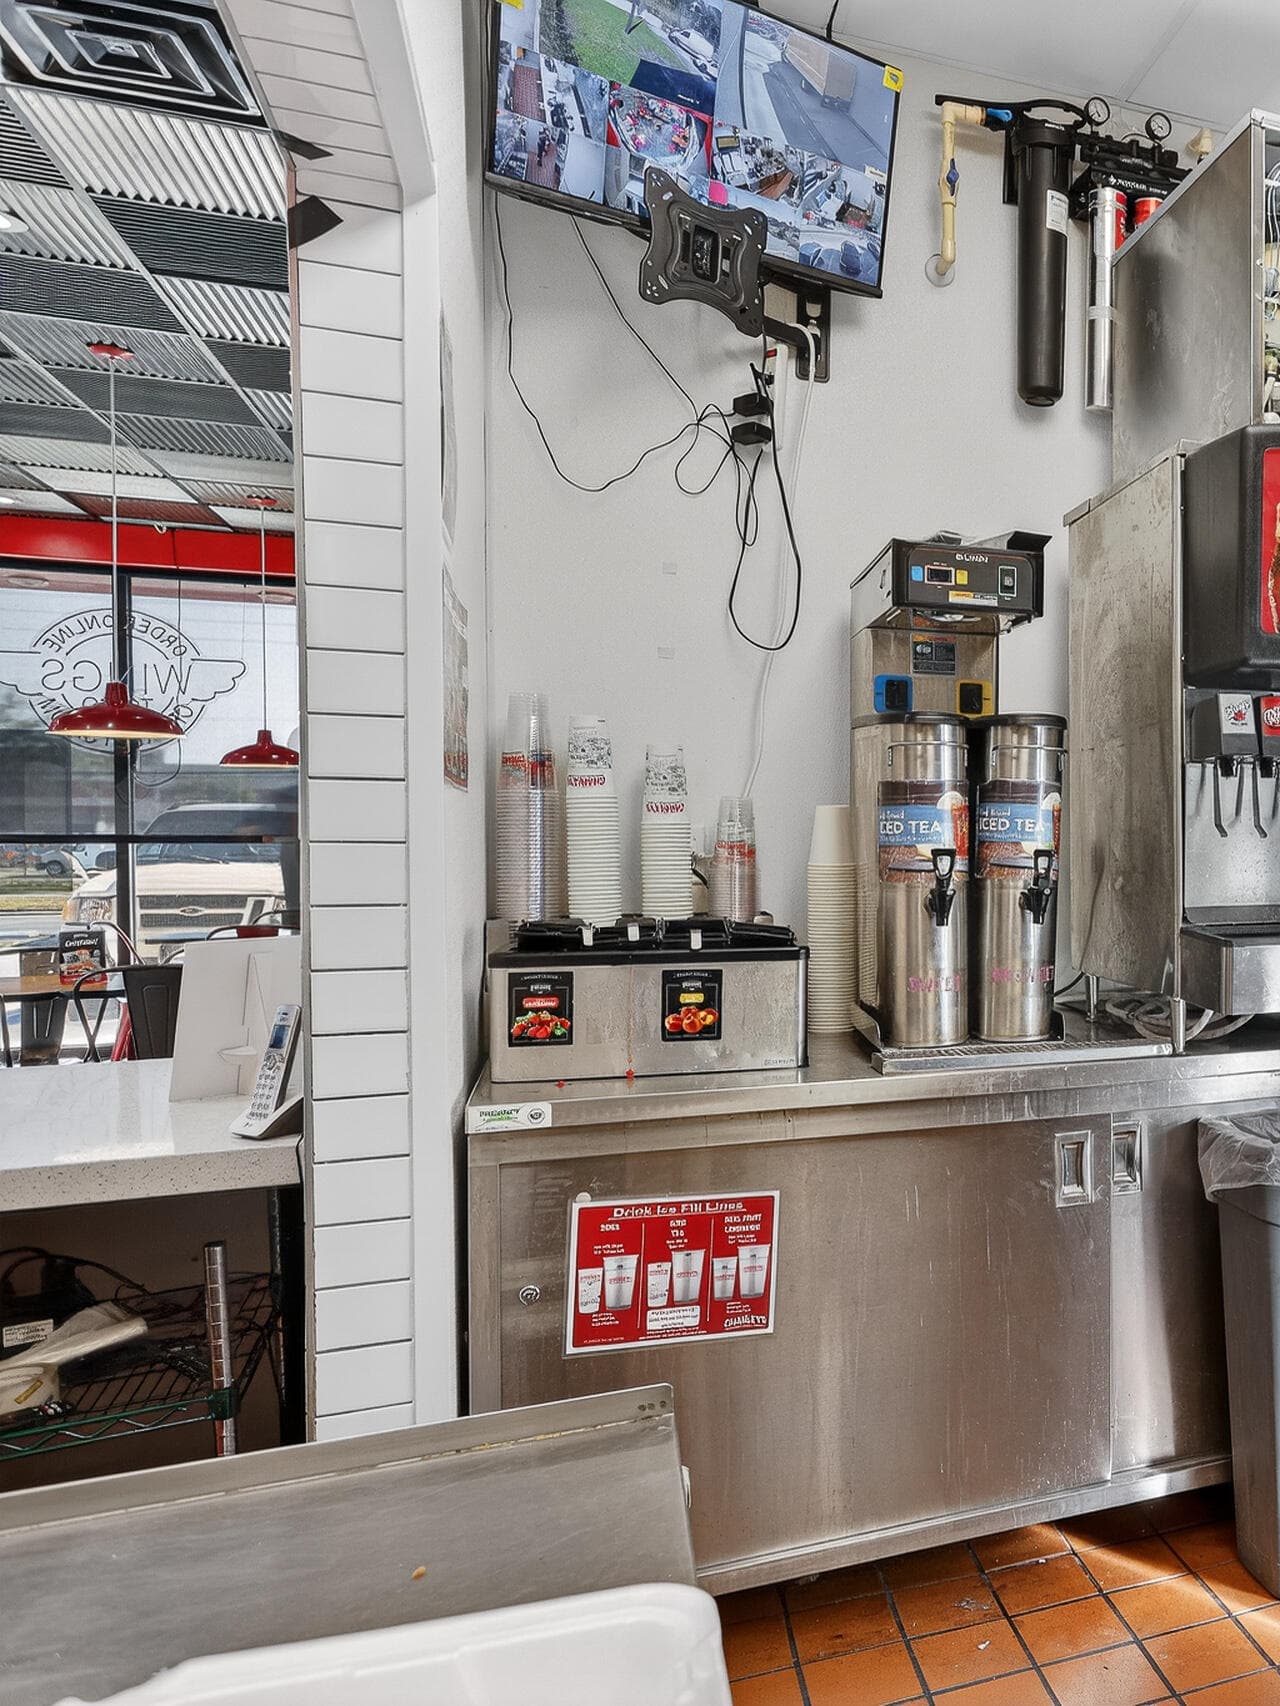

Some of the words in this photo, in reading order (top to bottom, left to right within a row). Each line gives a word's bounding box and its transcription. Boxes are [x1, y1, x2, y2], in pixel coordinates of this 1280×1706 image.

[908, 819, 942, 834] TEA
[613, 1205, 652, 1218] Drink
[680, 1203, 702, 1213] Fill
